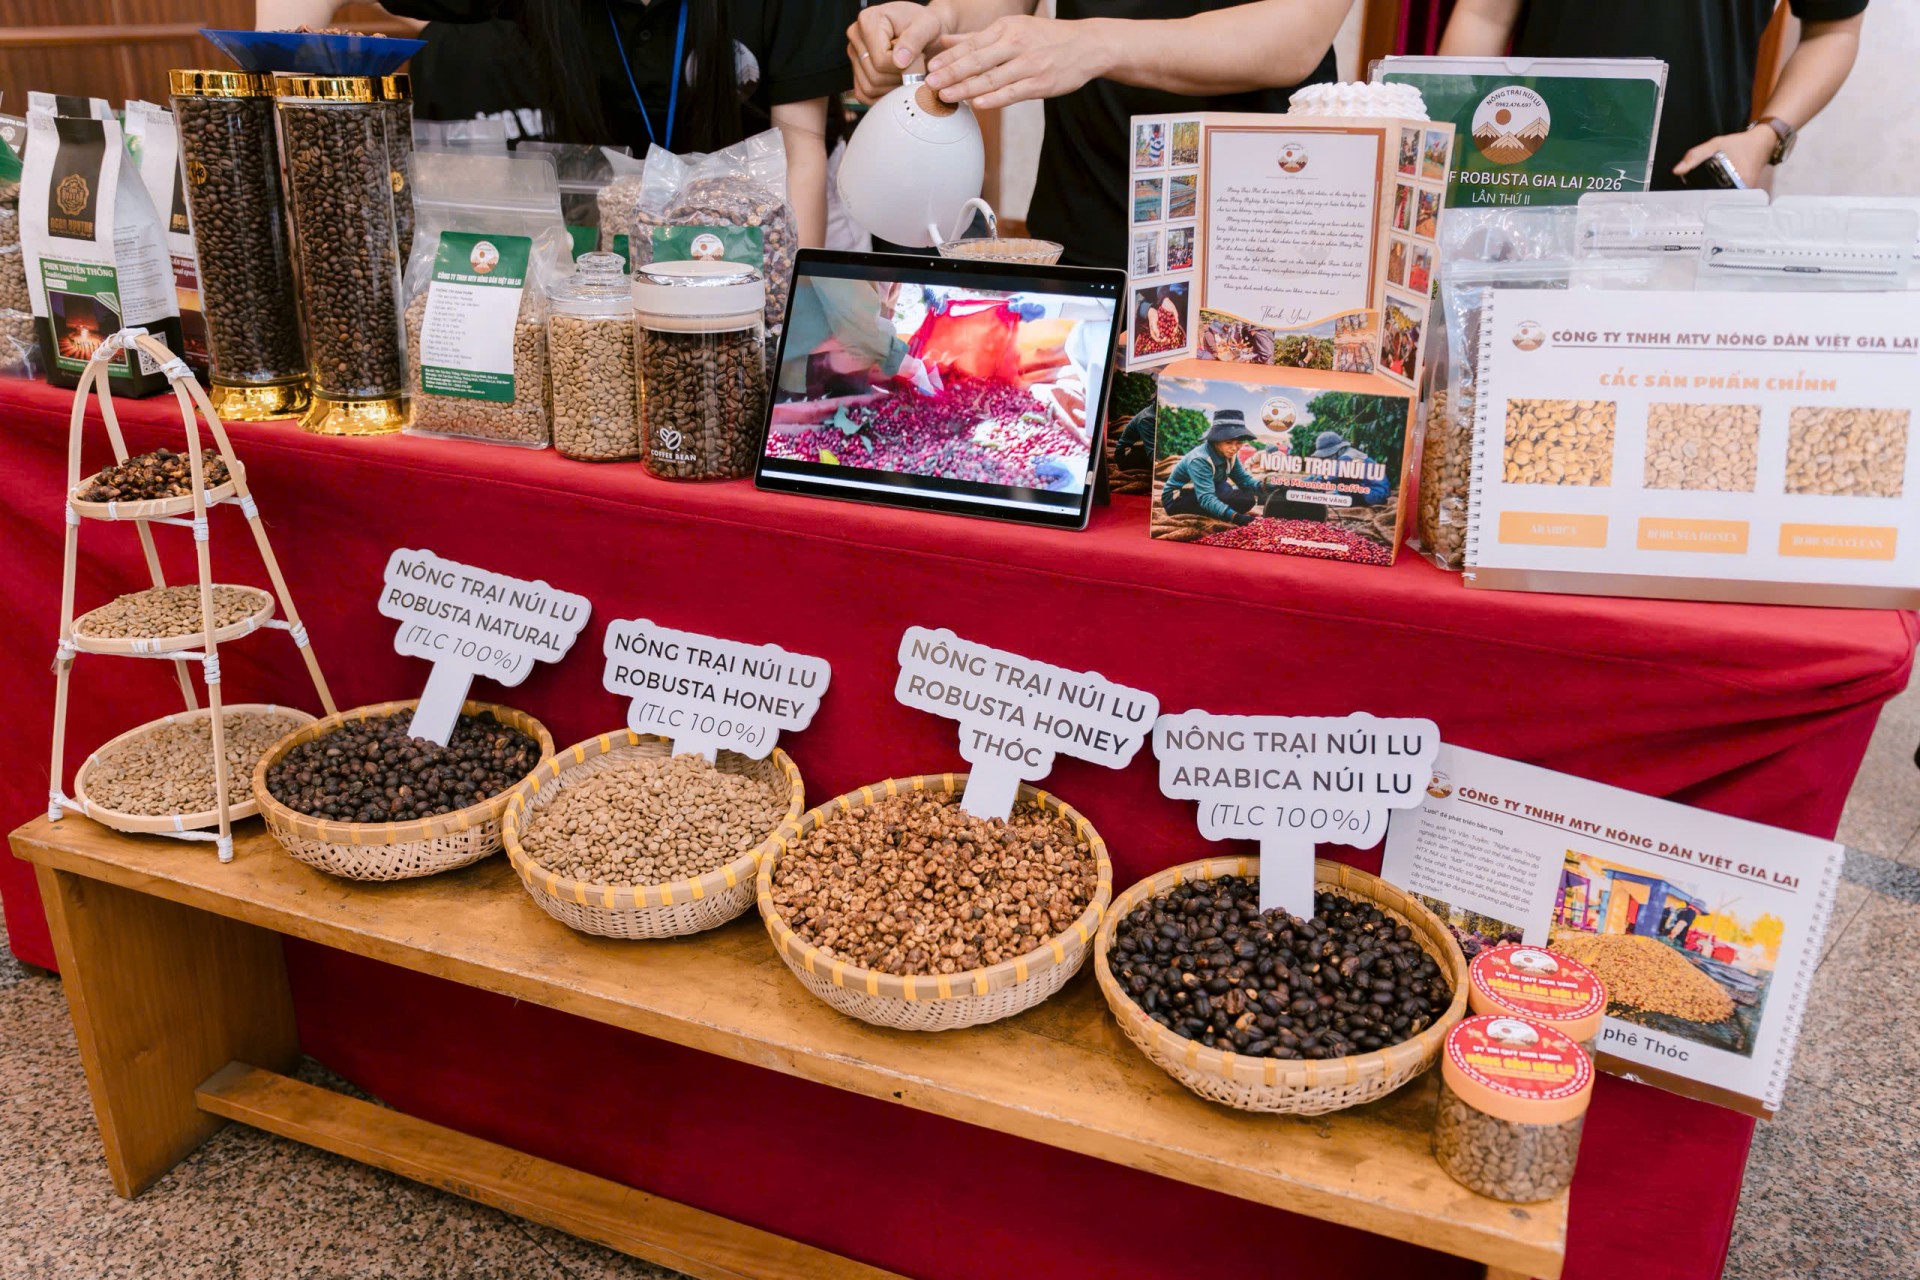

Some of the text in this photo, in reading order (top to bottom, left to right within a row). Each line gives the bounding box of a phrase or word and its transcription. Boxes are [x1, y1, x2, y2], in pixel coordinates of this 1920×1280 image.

[1532, 98, 1542, 107] LU
[1460, 171, 1529, 186] ROBUSTA
[1532, 174, 1557, 188] GIA
[1560, 176, 1583, 189] LAI
[1586, 177, 1622, 191] 2026
[1472, 189, 1531, 205] LẦN THỨ II
[86, 266, 114, 278] THỐNG
[1261, 305, 1311, 324] Thank You!
[1552, 329, 1918, 350] CÔNG TY TNHH MTV NÔNG DÂN VIỆT GIA LAI
[1600, 367, 1837, 391] CÁC SẢN PHẨM CHÍNH
[651, 450, 697, 461] COFFEE BEAN
[1304, 457, 1338, 479] TRẠI
[1339, 458, 1365, 479] NÚI
[1367, 463, 1386, 480] LU
[1271, 476, 1370, 494] Lu's Mountain Coffee
[396, 560, 577, 621] NÔNG TRẠI NÚI LU
[388, 588, 560, 651] ROBUSTA NATURAL
[406, 625, 522, 673] (TLC 100%)
[615, 633, 817, 688] NÔNG TRẠI NÚI LU
[615, 665, 804, 719] ROBUSTA HONEY
[911, 639, 1146, 722] NÔNG TRẠI NÚI LU
[639, 702, 765, 747] (TLC 100%)
[908, 675, 1129, 755] ROBUSTA HONEY
[972, 729, 1042, 767] THÓC
[1166, 725, 1422, 759] NÔNG TRẠI NÚI LU
[1172, 766, 1412, 794] ARABICA NÚI LU
[1210, 803, 1371, 834] (TLC 100%)
[1421, 820, 1433, 828] Theo
[1448, 814, 1461, 823] phát
[1489, 826, 1503, 836] vững
[1459, 787, 1799, 888] CÔNG TY TNHH MTV NÔNG DÂN VIỆT GIA LAI
[1603, 1028, 1689, 1061] phê Thóc
